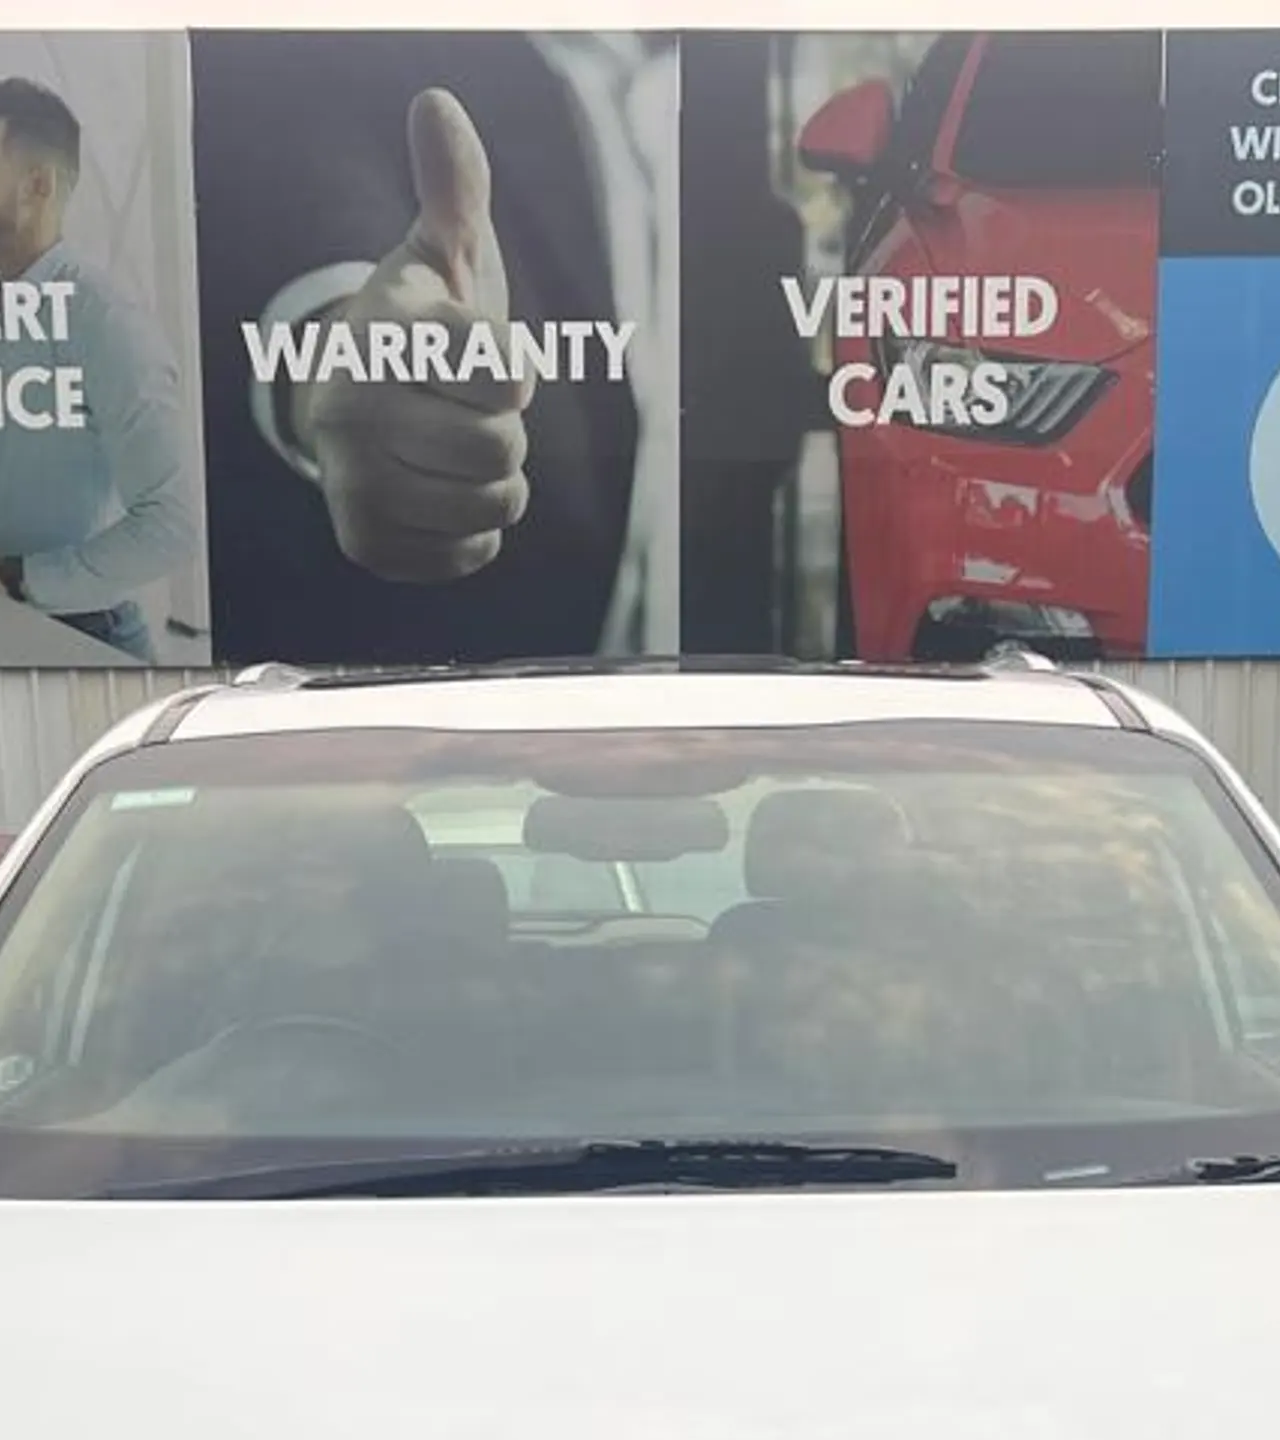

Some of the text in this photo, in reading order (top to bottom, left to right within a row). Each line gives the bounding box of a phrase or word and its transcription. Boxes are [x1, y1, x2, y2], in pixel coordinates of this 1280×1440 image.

[781, 277, 1058, 338] VERIFIED
[241, 321, 637, 383] WARRANTY
[827, 364, 1010, 426] CARS
